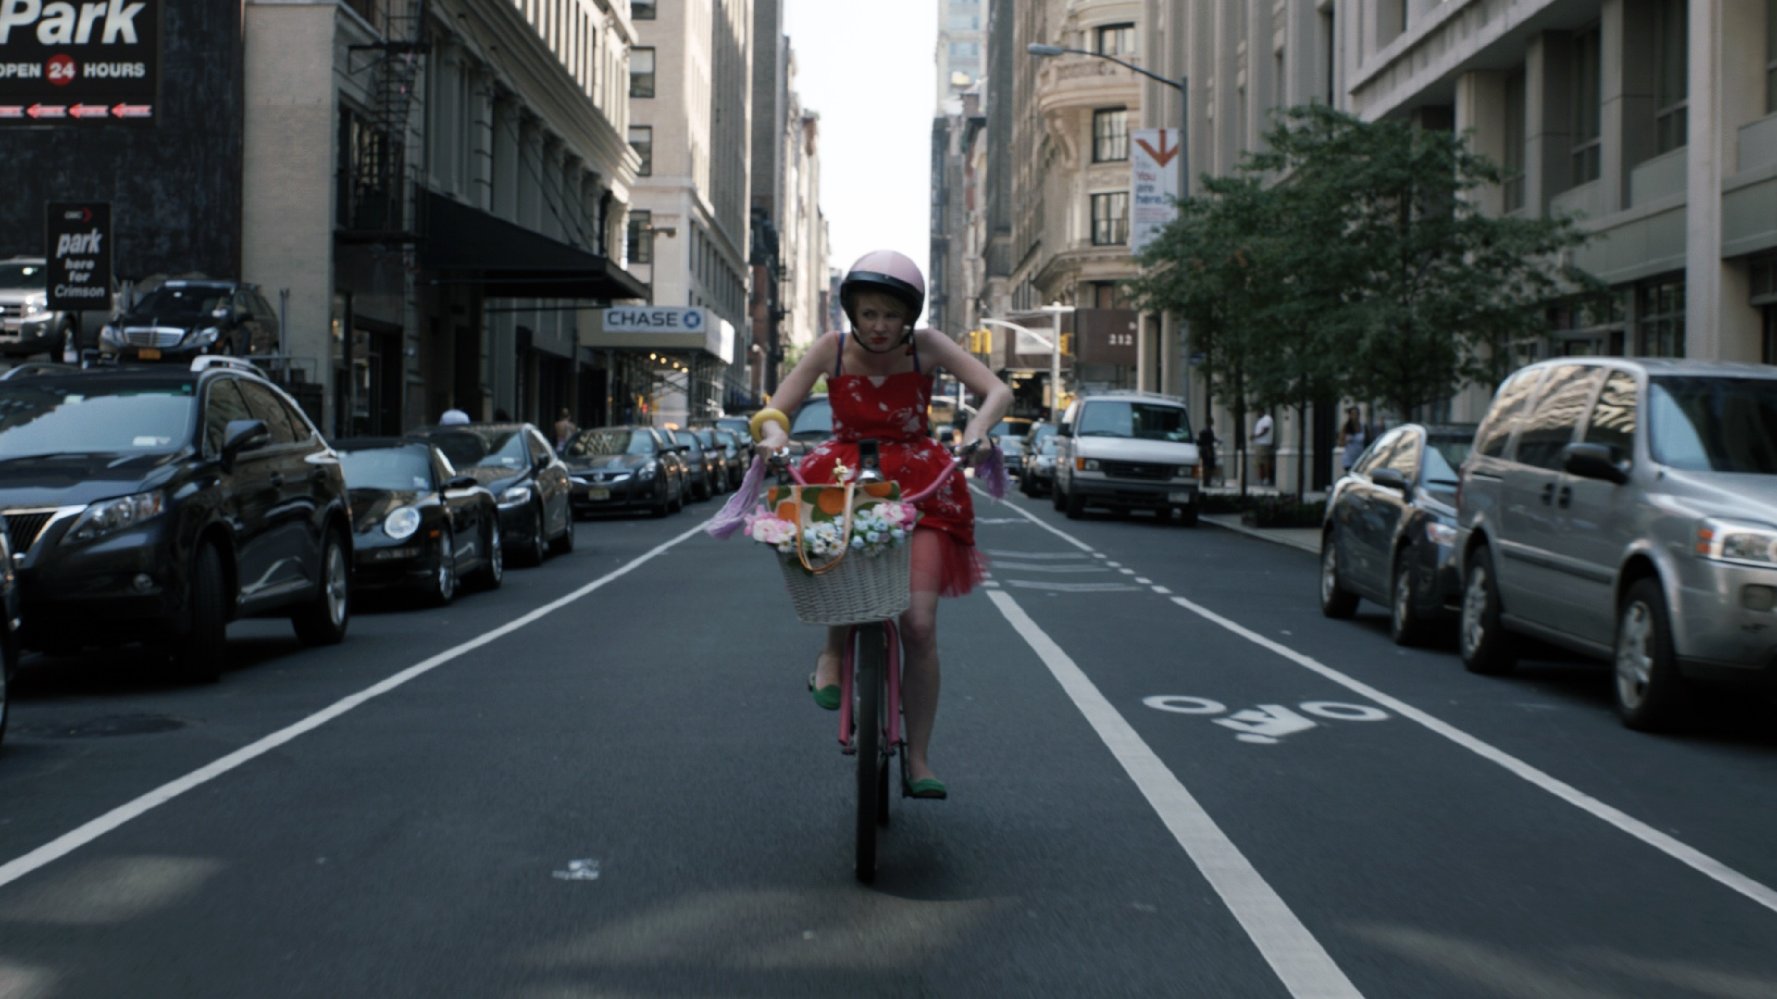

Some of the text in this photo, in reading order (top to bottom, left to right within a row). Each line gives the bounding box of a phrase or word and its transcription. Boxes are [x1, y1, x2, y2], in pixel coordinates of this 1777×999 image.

[0, 0, 146, 45] Park
[49, 62, 76, 79] 24
[83, 62, 146, 78] HOURS
[56, 228, 103, 258] park
[65, 258, 95, 270] here
[69, 271, 91, 282] for
[55, 284, 105, 298] Crimson
[607, 311, 678, 327] CHASE
[1109, 333, 1132, 345] 212
